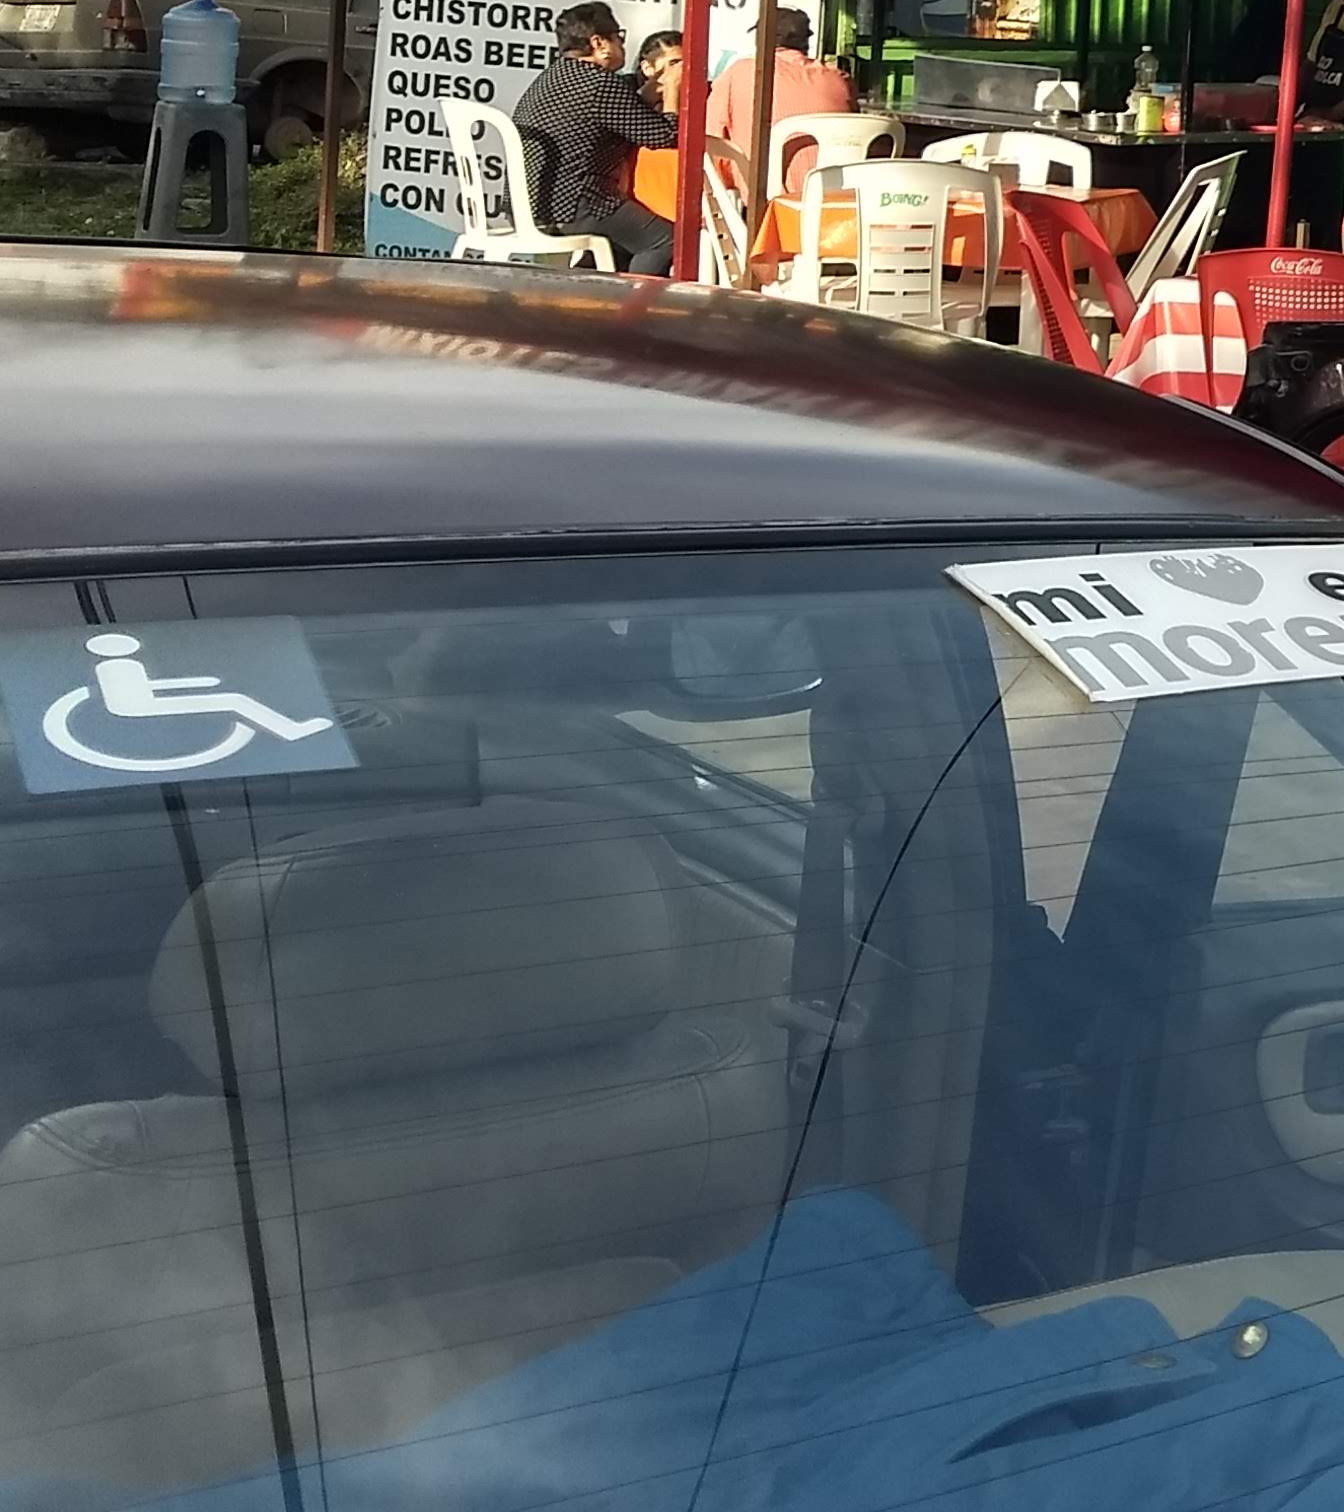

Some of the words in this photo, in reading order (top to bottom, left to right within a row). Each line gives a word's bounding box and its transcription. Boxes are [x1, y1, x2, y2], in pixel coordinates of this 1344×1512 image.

[390, 32, 473, 63] ROAS
[387, 70, 495, 103] QUESO
[384, 108, 486, 141] POLO
[380, 183, 445, 213] CON
[995, 572, 1144, 626] mi
